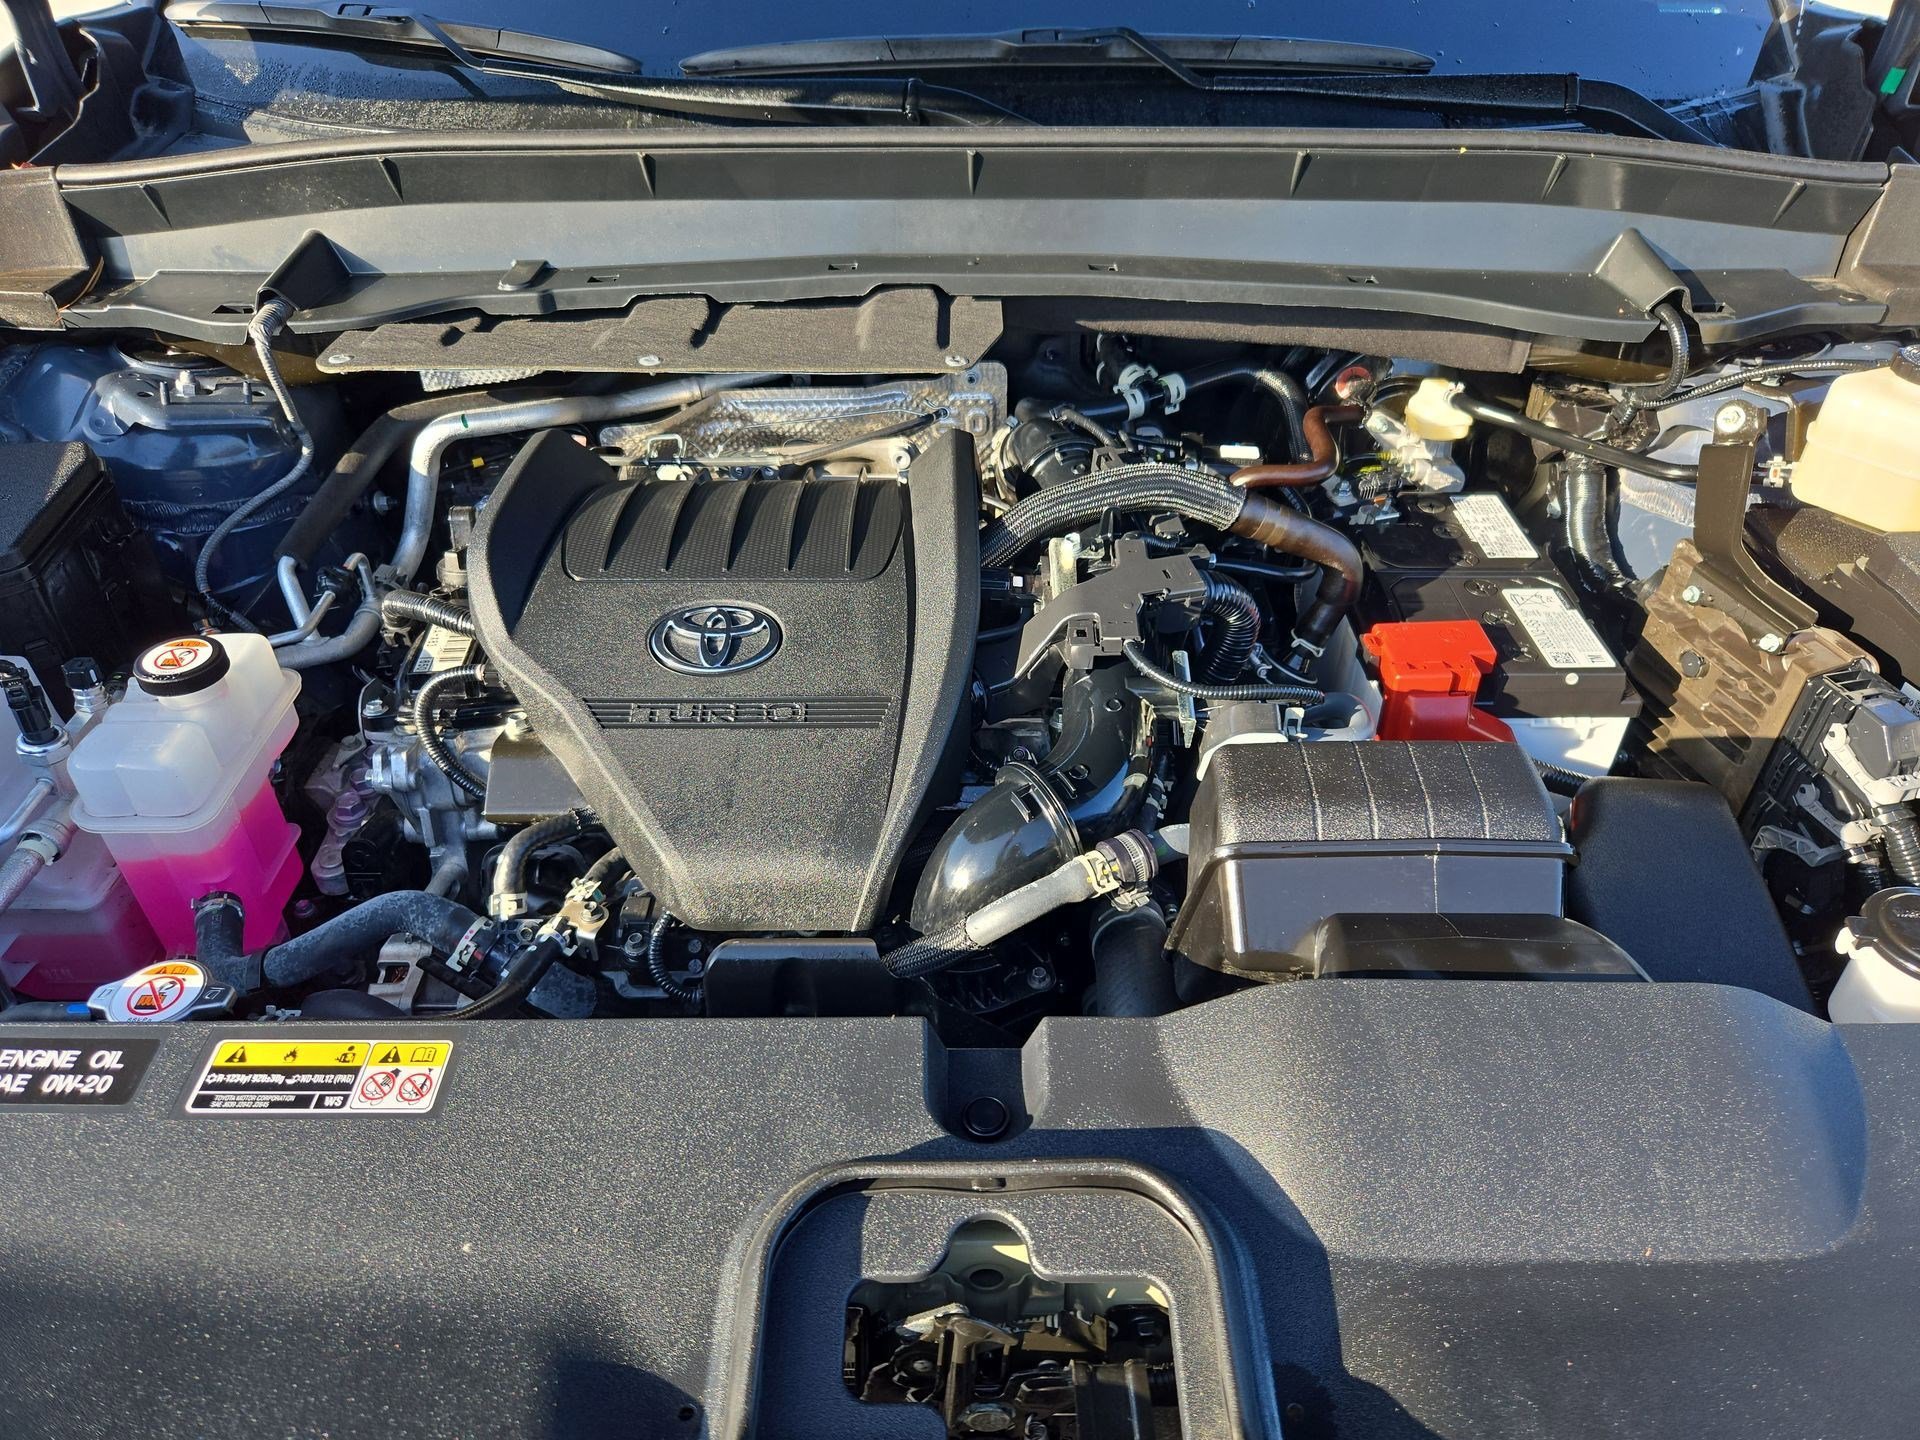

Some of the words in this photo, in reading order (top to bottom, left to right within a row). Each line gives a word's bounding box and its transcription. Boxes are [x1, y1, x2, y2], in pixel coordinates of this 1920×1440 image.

[630, 702, 808, 723] TURBO
[0, 1050, 81, 1069] ENGINE
[89, 1050, 124, 1069] OIL
[0, 1074, 32, 1093] AE
[40, 1074, 114, 1094] 0W-20
[323, 1095, 344, 1107] WS
